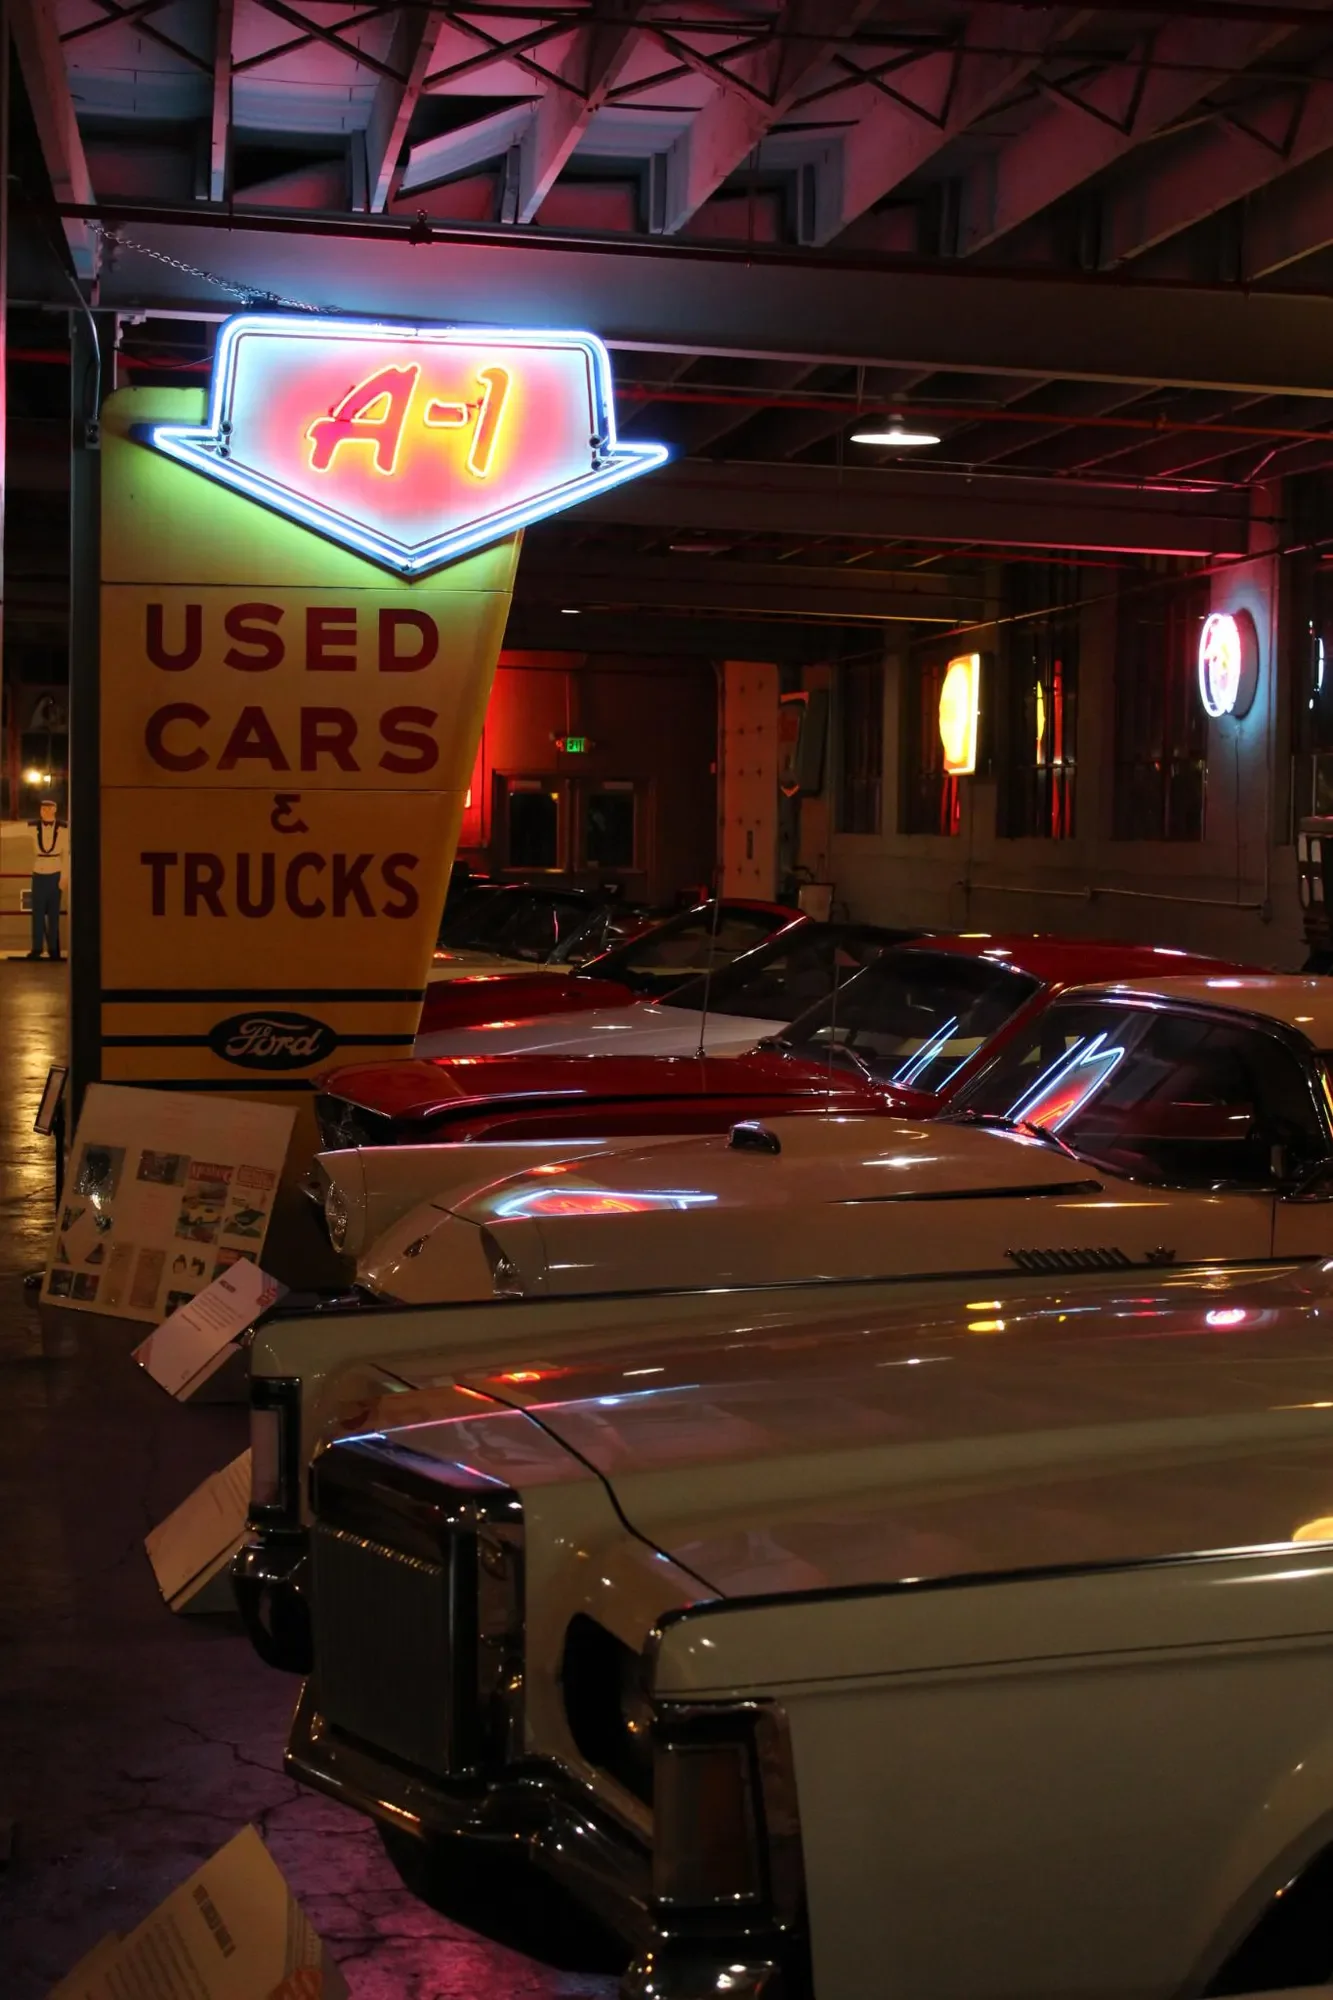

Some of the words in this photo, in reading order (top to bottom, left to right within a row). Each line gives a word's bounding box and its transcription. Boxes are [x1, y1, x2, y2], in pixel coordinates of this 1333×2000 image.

[306, 362, 511, 477] A-1
[146, 603, 439, 672] USED
[145, 702, 440, 774] CARS
[270, 794, 309, 833] &
[140, 852, 420, 918] TRUCKS
[225, 1018, 323, 1058] Ford
